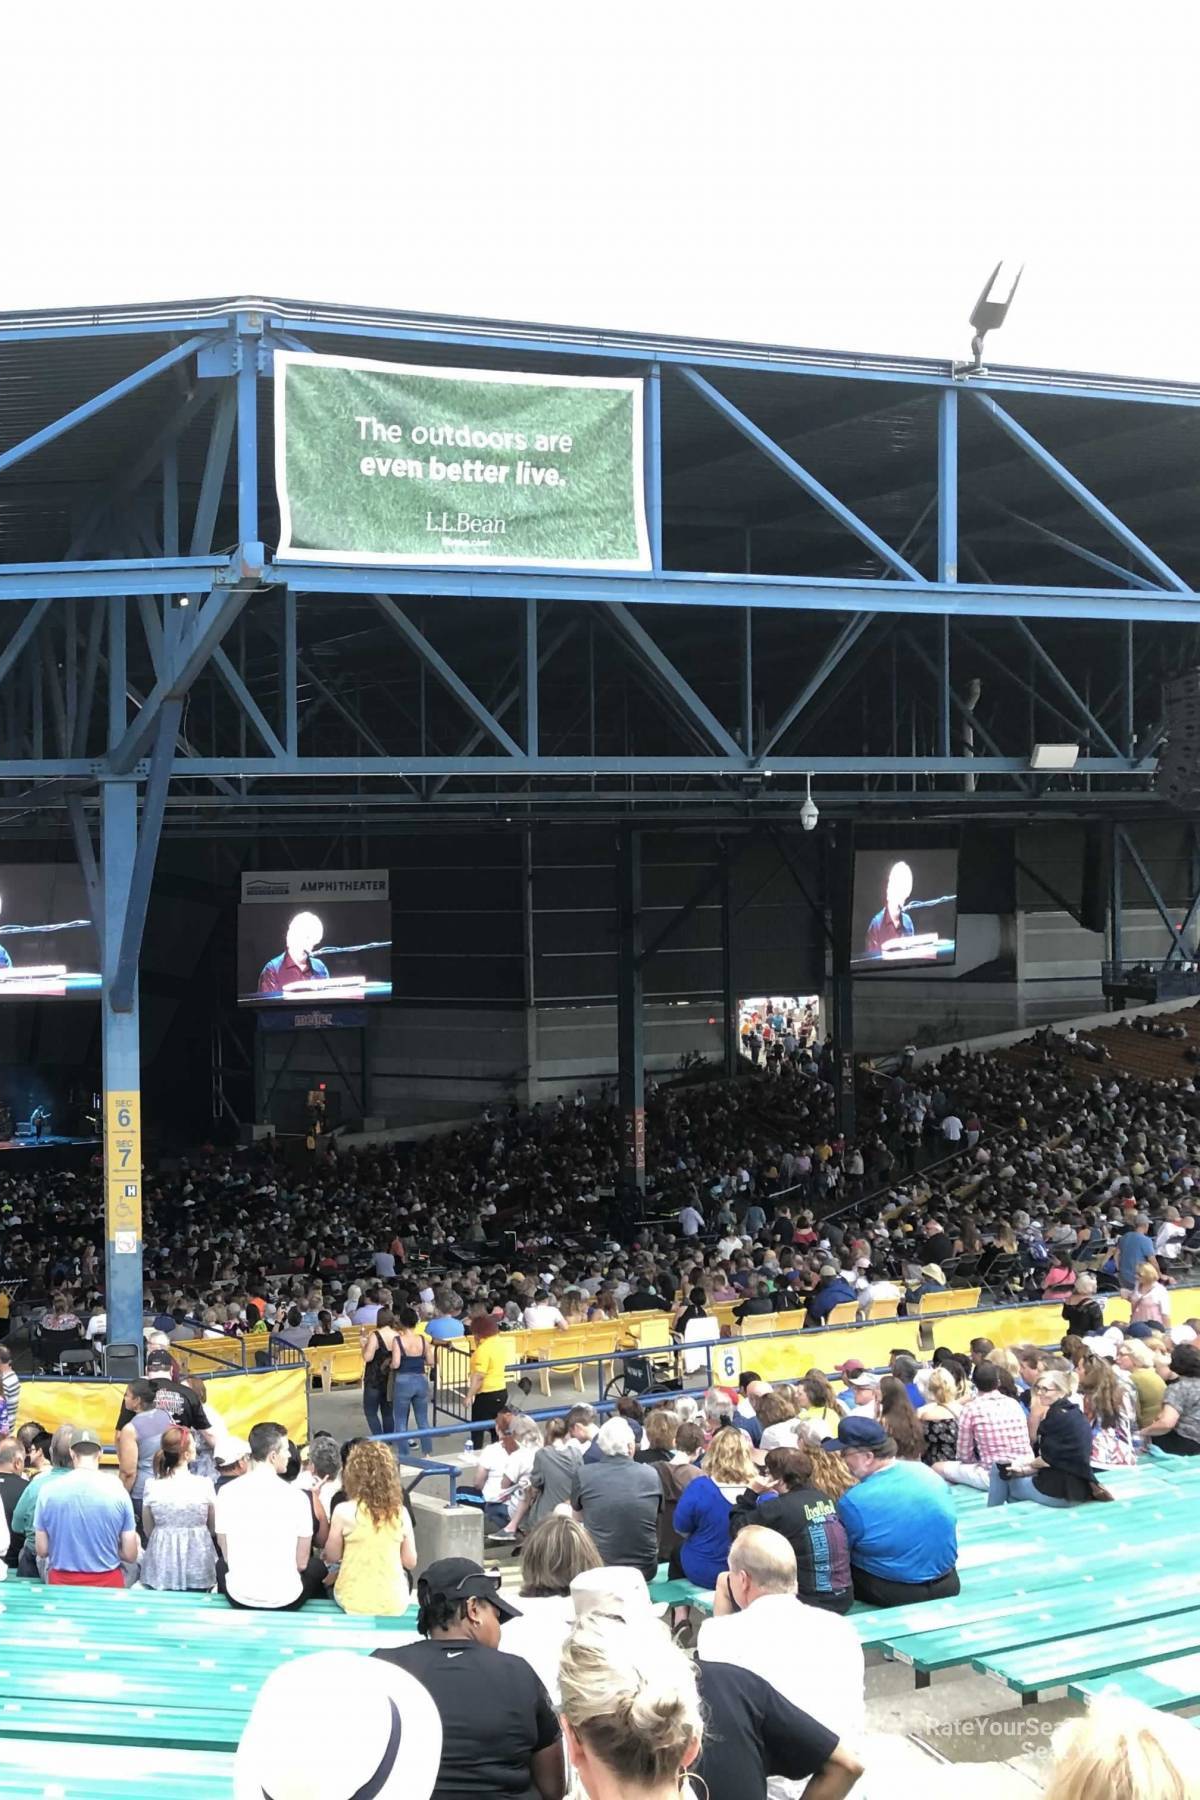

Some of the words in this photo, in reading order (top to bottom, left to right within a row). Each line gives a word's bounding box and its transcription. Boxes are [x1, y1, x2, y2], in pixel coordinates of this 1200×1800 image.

[355, 416, 401, 443] The
[411, 424, 527, 450] outdoors
[535, 433, 573, 453] are
[360, 455, 422, 479] even
[429, 456, 510, 483] better
[516, 461, 567, 486] live.
[300, 881, 386, 892] AMPHITHEATER
[115, 1099, 133, 1107] SEC
[118, 1109, 131, 1127] 6
[115, 1140, 134, 1148] SEC
[118, 1149, 132, 1167] 7
[724, 1356, 735, 1376] 6
